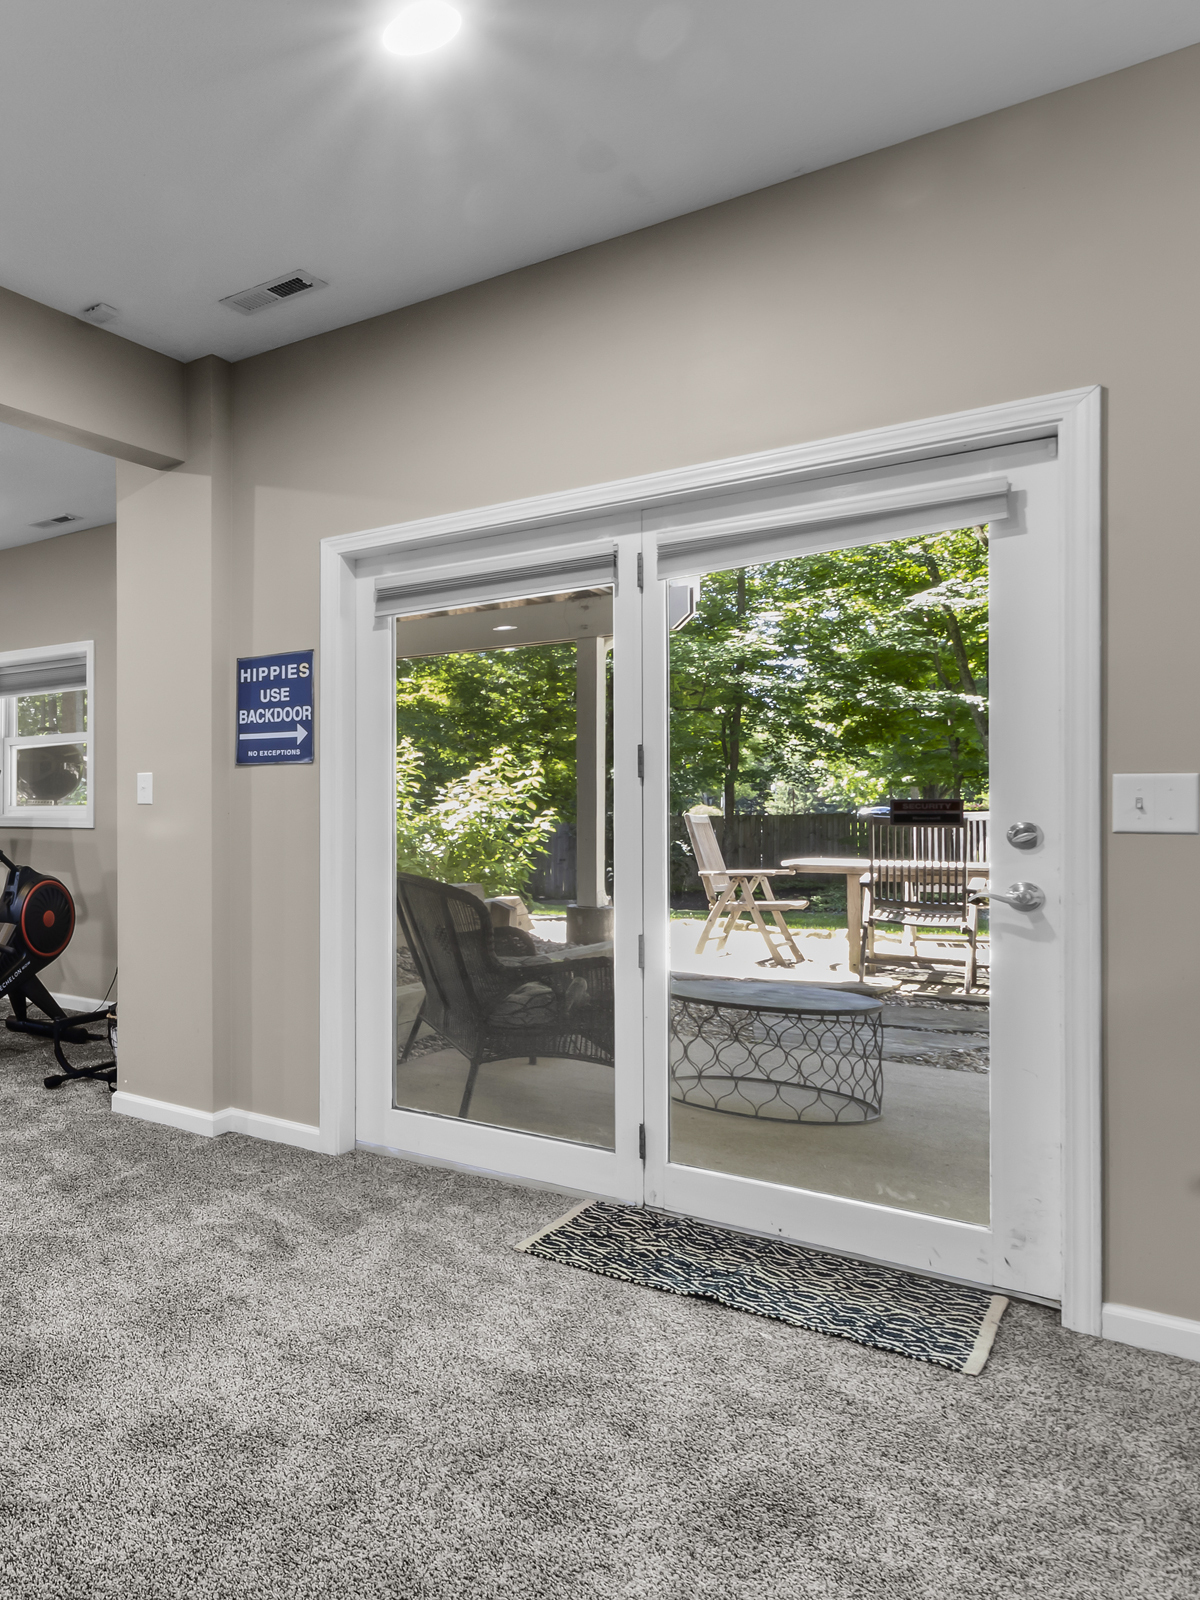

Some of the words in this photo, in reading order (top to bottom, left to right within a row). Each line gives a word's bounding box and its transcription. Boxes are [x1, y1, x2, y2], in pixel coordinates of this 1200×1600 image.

[240, 663, 310, 683] HIPPIES
[260, 687, 290, 703] USE
[239, 705, 312, 724] BACKDOOR
[0, 968, 22, 991] ECHELON
